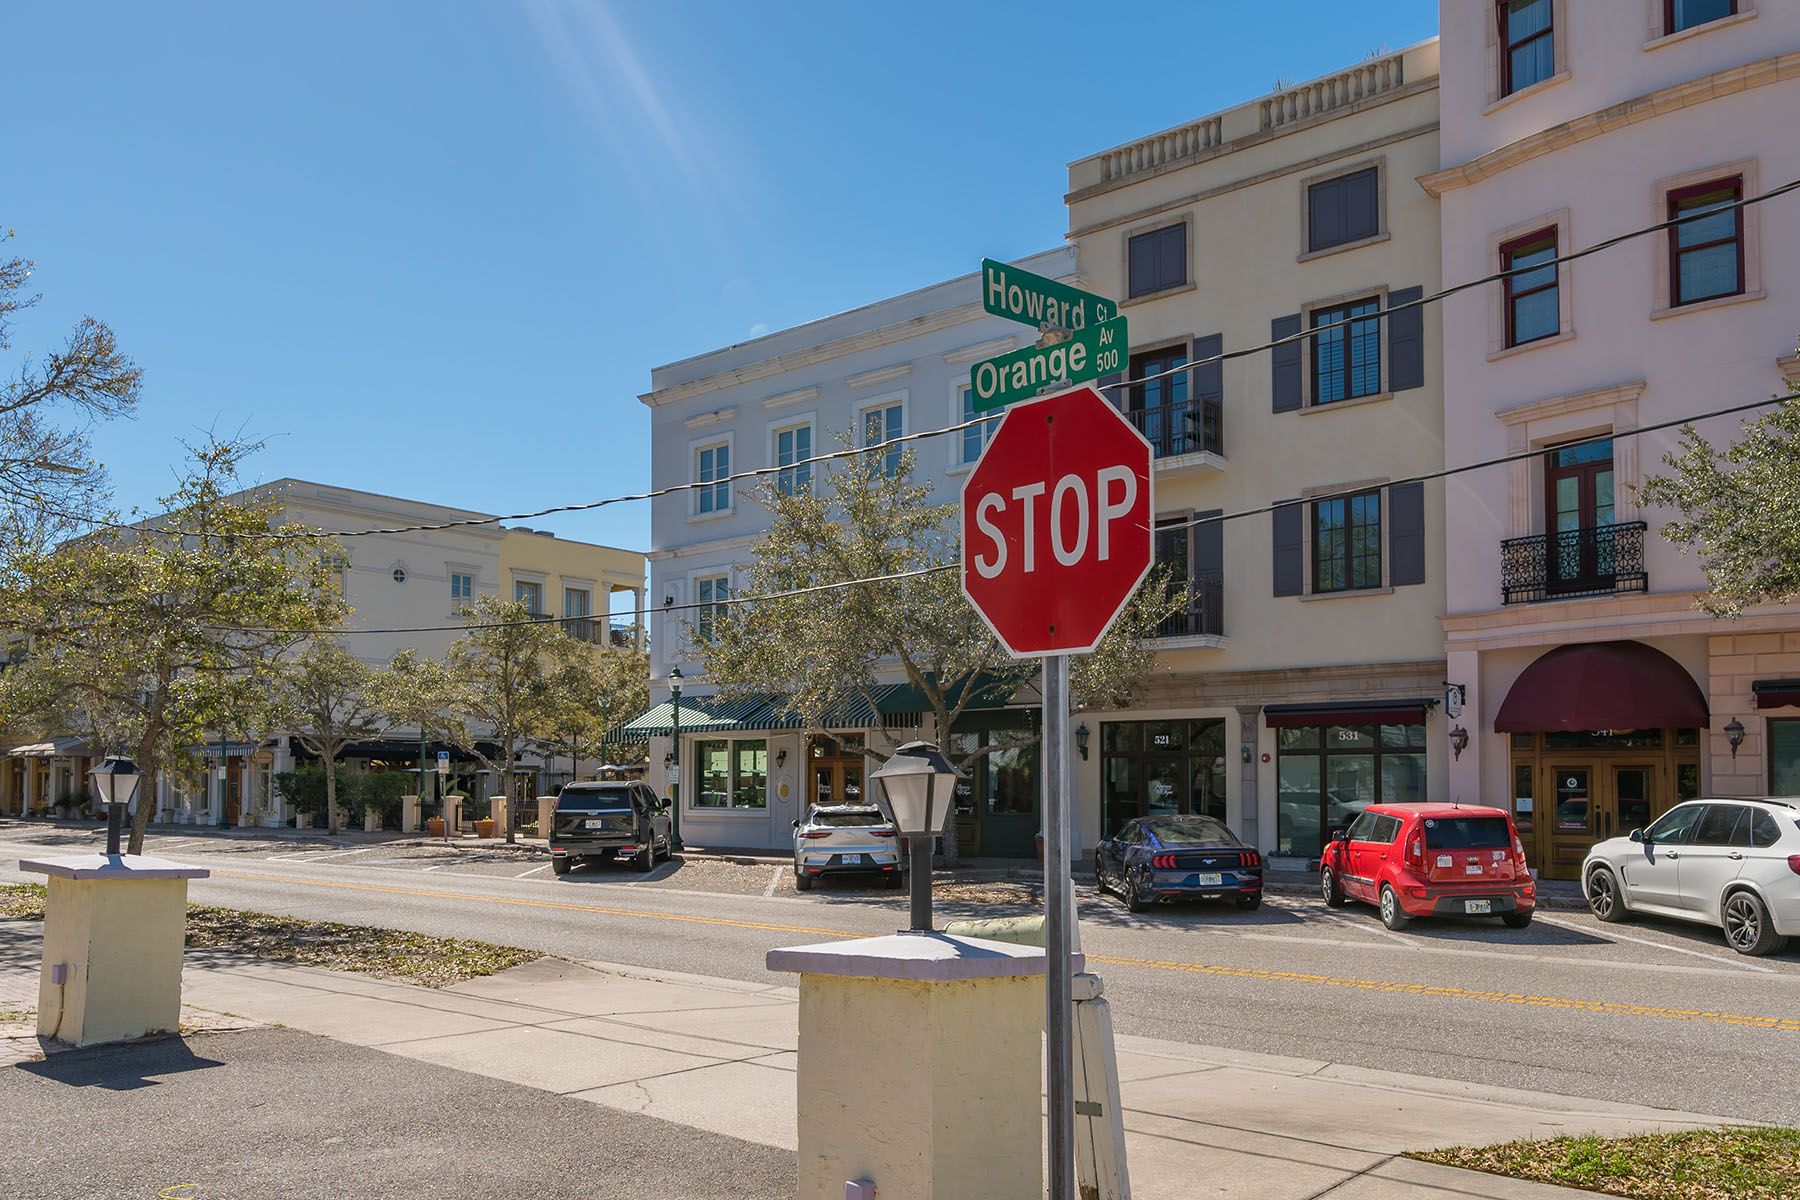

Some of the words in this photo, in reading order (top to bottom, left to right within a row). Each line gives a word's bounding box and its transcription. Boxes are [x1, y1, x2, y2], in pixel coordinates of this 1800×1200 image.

[988, 268, 1085, 331] Howard
[1096, 303, 1108, 322] Ct
[976, 342, 1087, 399] Orange
[1099, 327, 1114, 347] Av
[1096, 349, 1119, 373] 500
[974, 464, 1138, 580] STOP
[1154, 735, 1169, 744] 521
[1338, 731, 1360, 741] 531
